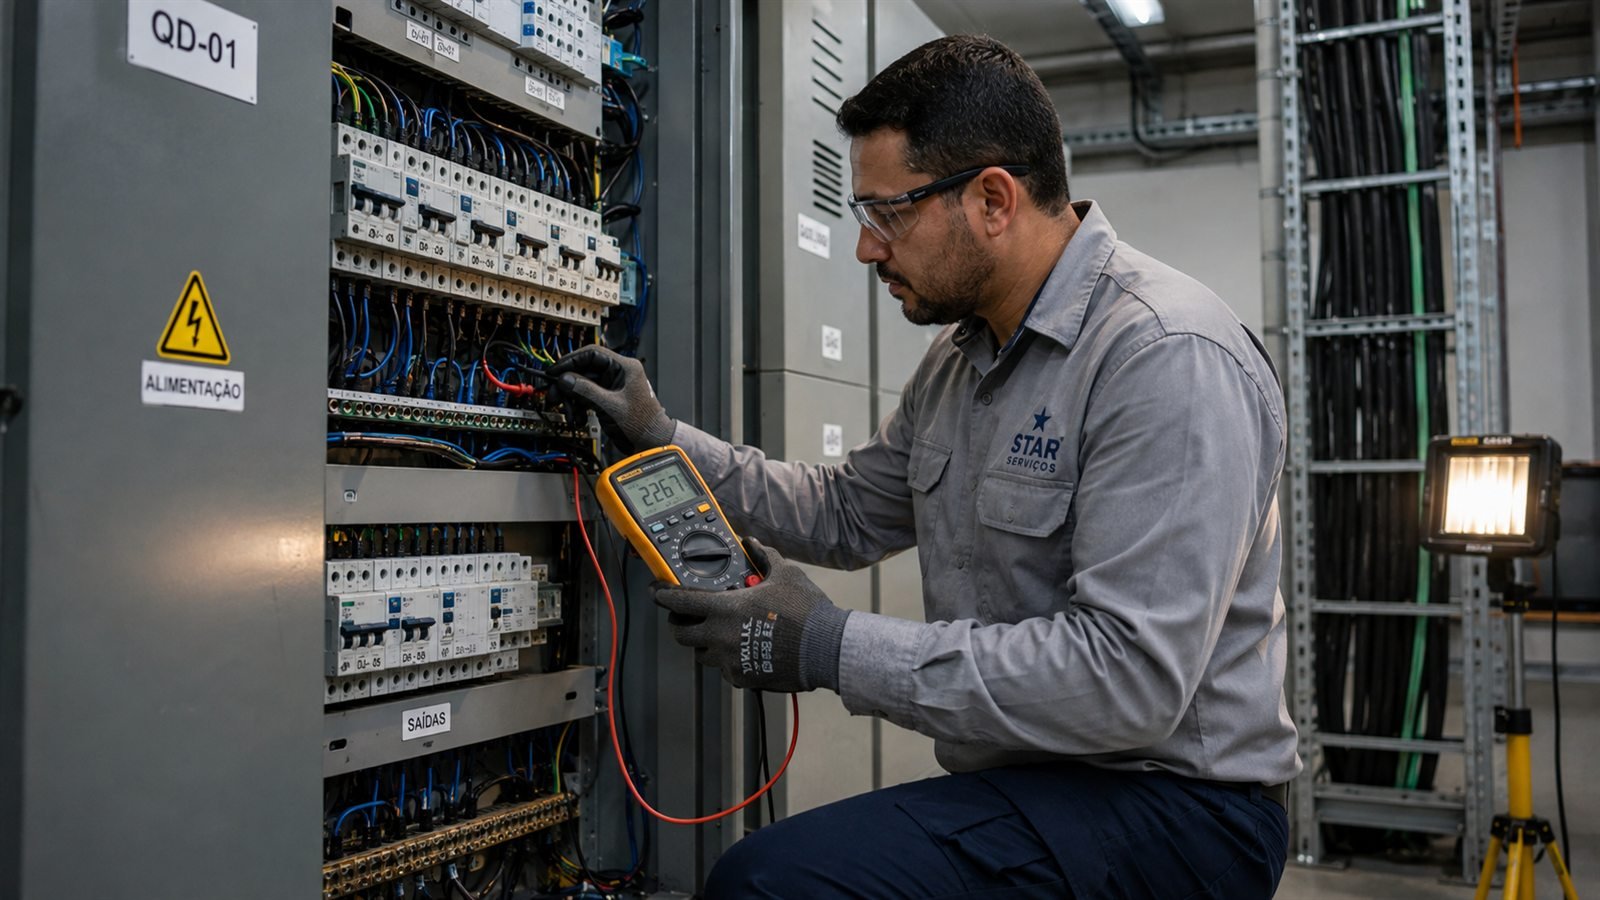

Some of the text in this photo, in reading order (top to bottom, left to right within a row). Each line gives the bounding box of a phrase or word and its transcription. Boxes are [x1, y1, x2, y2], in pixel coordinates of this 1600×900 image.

[151, 10, 237, 69] QD-01
[146, 374, 241, 401] ALIMENTAÇÃO
[1011, 433, 1060, 460] STAR
[1006, 456, 1056, 473] SERVIÇOS
[408, 711, 446, 732] SAÍDAS
